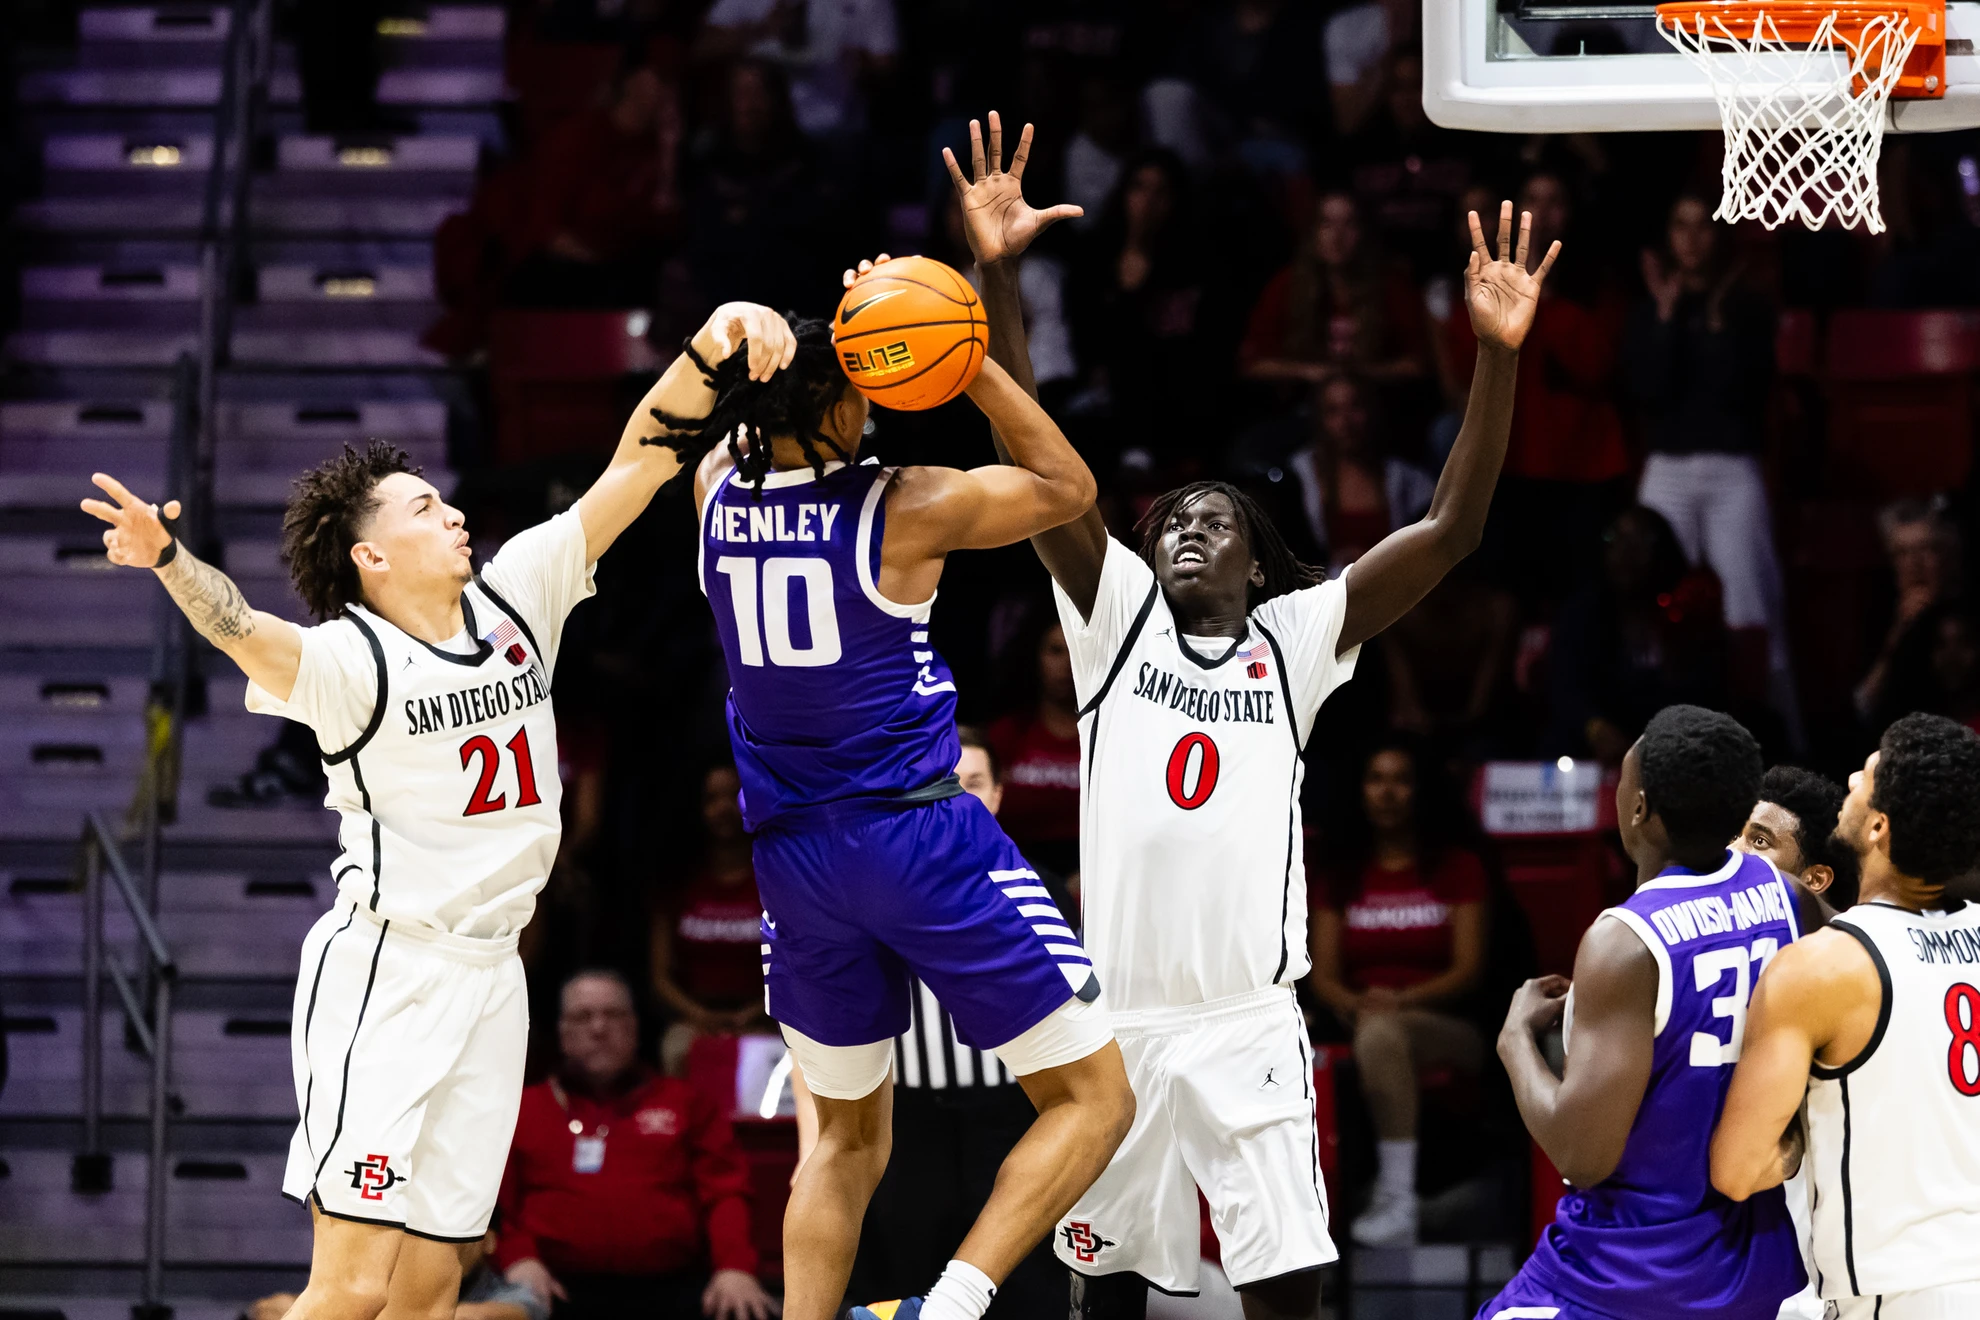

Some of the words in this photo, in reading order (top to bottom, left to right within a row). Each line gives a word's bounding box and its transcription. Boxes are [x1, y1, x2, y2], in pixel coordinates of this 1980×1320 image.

[843, 341, 911, 372] ELITE
[710, 500, 841, 543] HENLEY
[716, 555, 842, 667] 10
[405, 695, 445, 735] SAN
[446, 680, 510, 729] DIEGO
[1133, 661, 1174, 706] SAN
[1169, 676, 1220, 724] DIEGO
[1223, 688, 1274, 724] STATE
[459, 723, 542, 817] 21
[1165, 731, 1220, 811] 0
[1650, 881, 1787, 945] OWUSU-ANANE
[1907, 926, 1980, 964] SIMMON
[1944, 982, 1980, 1097] 8
